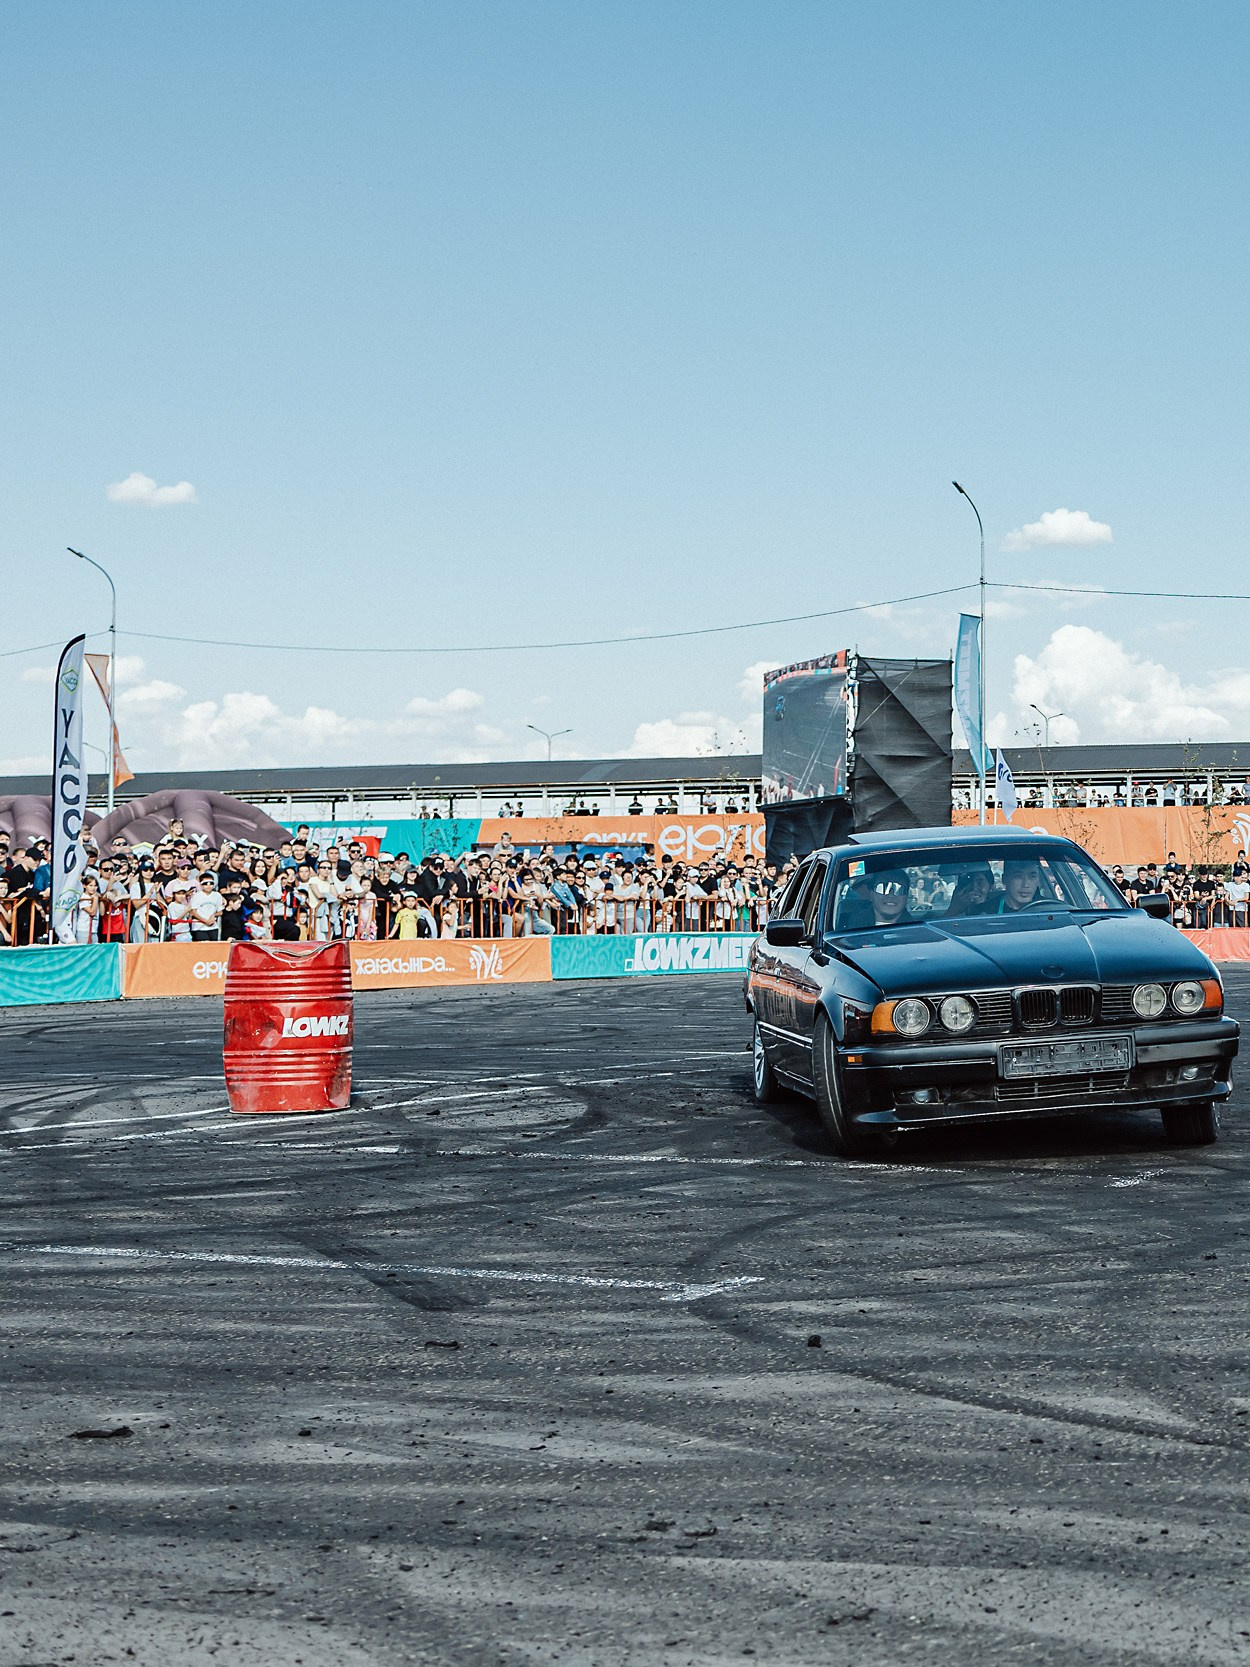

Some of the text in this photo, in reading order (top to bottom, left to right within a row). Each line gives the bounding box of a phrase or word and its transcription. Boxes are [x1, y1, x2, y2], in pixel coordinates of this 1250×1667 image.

[58, 708, 81, 874] YACCO
[633, 937, 756, 972] LOWKZMEE
[281, 1015, 349, 1038] LOWKZ
